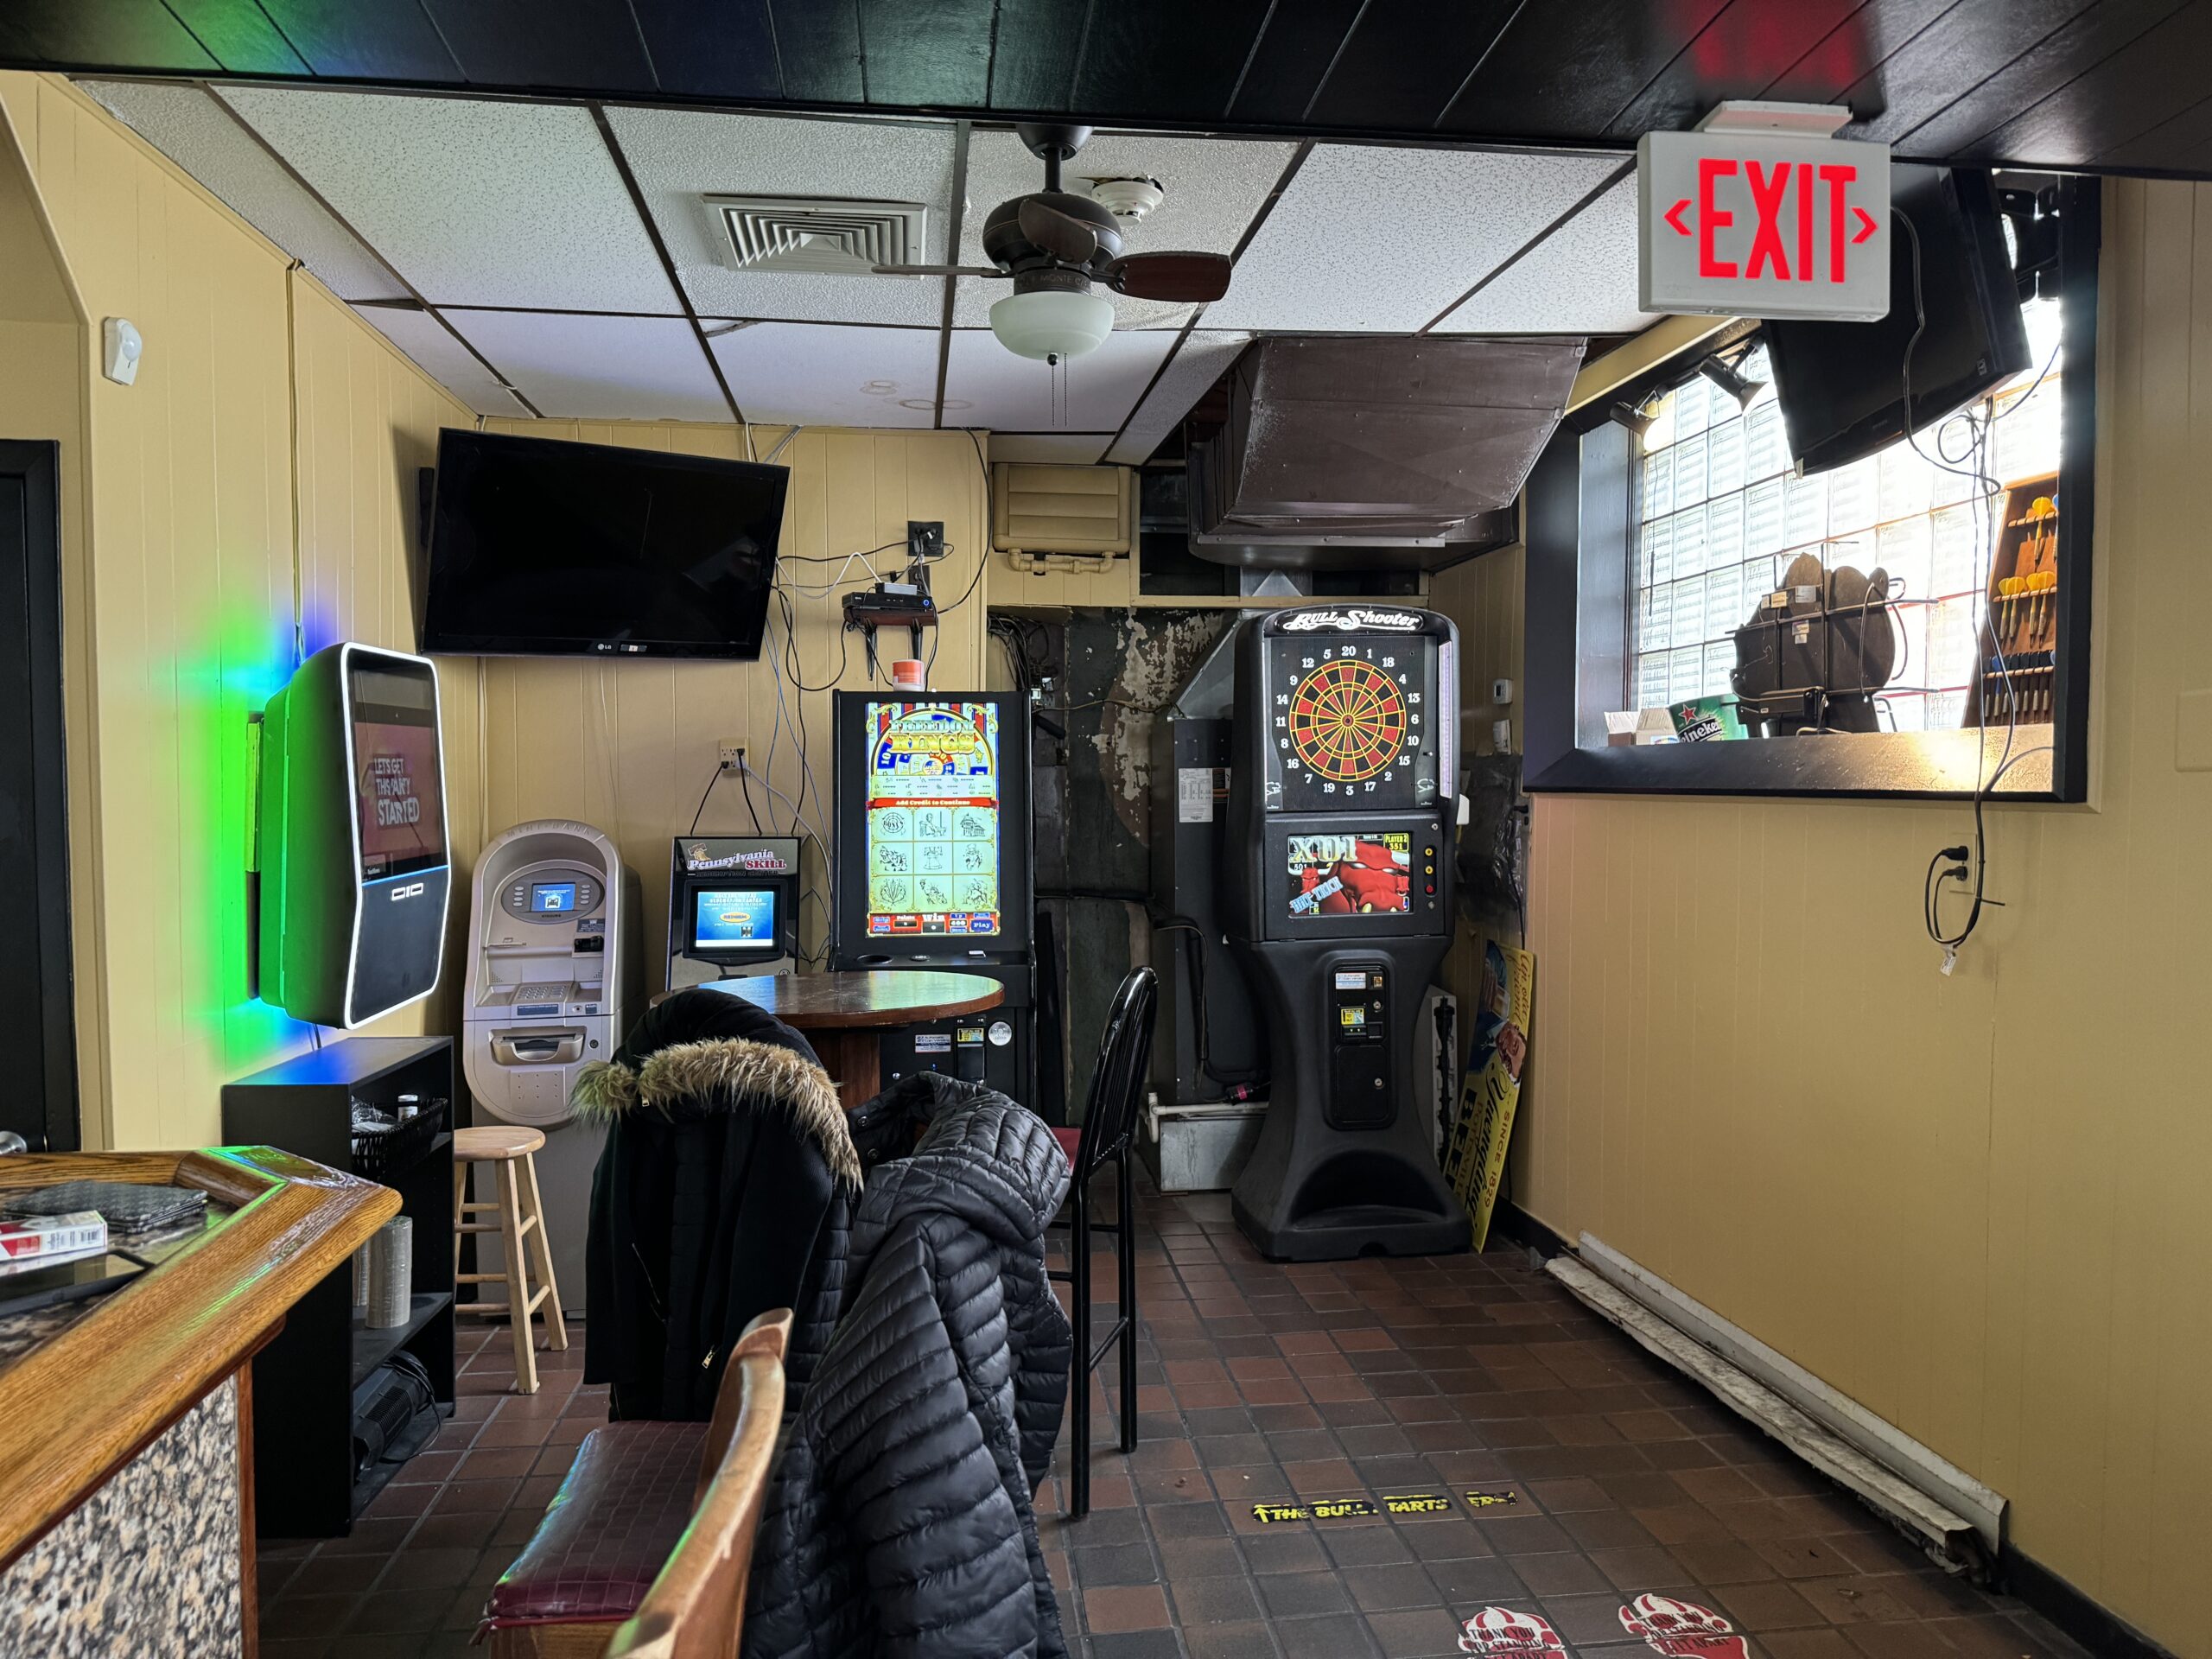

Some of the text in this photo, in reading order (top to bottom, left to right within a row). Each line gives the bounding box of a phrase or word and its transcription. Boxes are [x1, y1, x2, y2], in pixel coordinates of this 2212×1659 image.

[1698, 157, 1857, 283] EXIT
[1283, 609, 1420, 630] BULL Shooter
[1323, 649, 1332, 659] 5
[1341, 645, 1357, 656] 20
[1366, 649, 1373, 658] 1
[1301, 658, 1315, 668] 12
[1382, 657, 1395, 667] 18
[1289, 675, 1299, 685] 9
[1398, 674, 1407, 684] 4
[1275, 695, 1289, 704] 14
[1407, 693, 1421, 702] 13
[1274, 716, 1287, 727] 11
[1410, 714, 1420, 724] 6
[889, 720, 976, 733] FREEDOM
[1681, 721, 1721, 742] eineke
[1280, 738, 1289, 748] 8
[1407, 735, 1420, 746] 10
[374, 758, 404, 774] LET'S GET
[1286, 759, 1300, 768] 16
[1398, 755, 1411, 766] 15
[1304, 773, 1313, 784] 7
[1384, 772, 1393, 781] 2
[376, 778, 392, 795] THIS
[1323, 783, 1336, 792] 19
[1345, 785, 1354, 795] 3
[1363, 781, 1376, 791] 17
[378, 797, 420, 826] STARTED
[688, 849, 774, 870] Pennsylvania
[745, 859, 787, 870] SKILL
[923, 912, 944, 921] Win
[1507, 954, 1522, 1025] friend
[1484, 1111, 1510, 1208] SINCE 1829
[1468, 1626, 1535, 1640] THANK YOU
